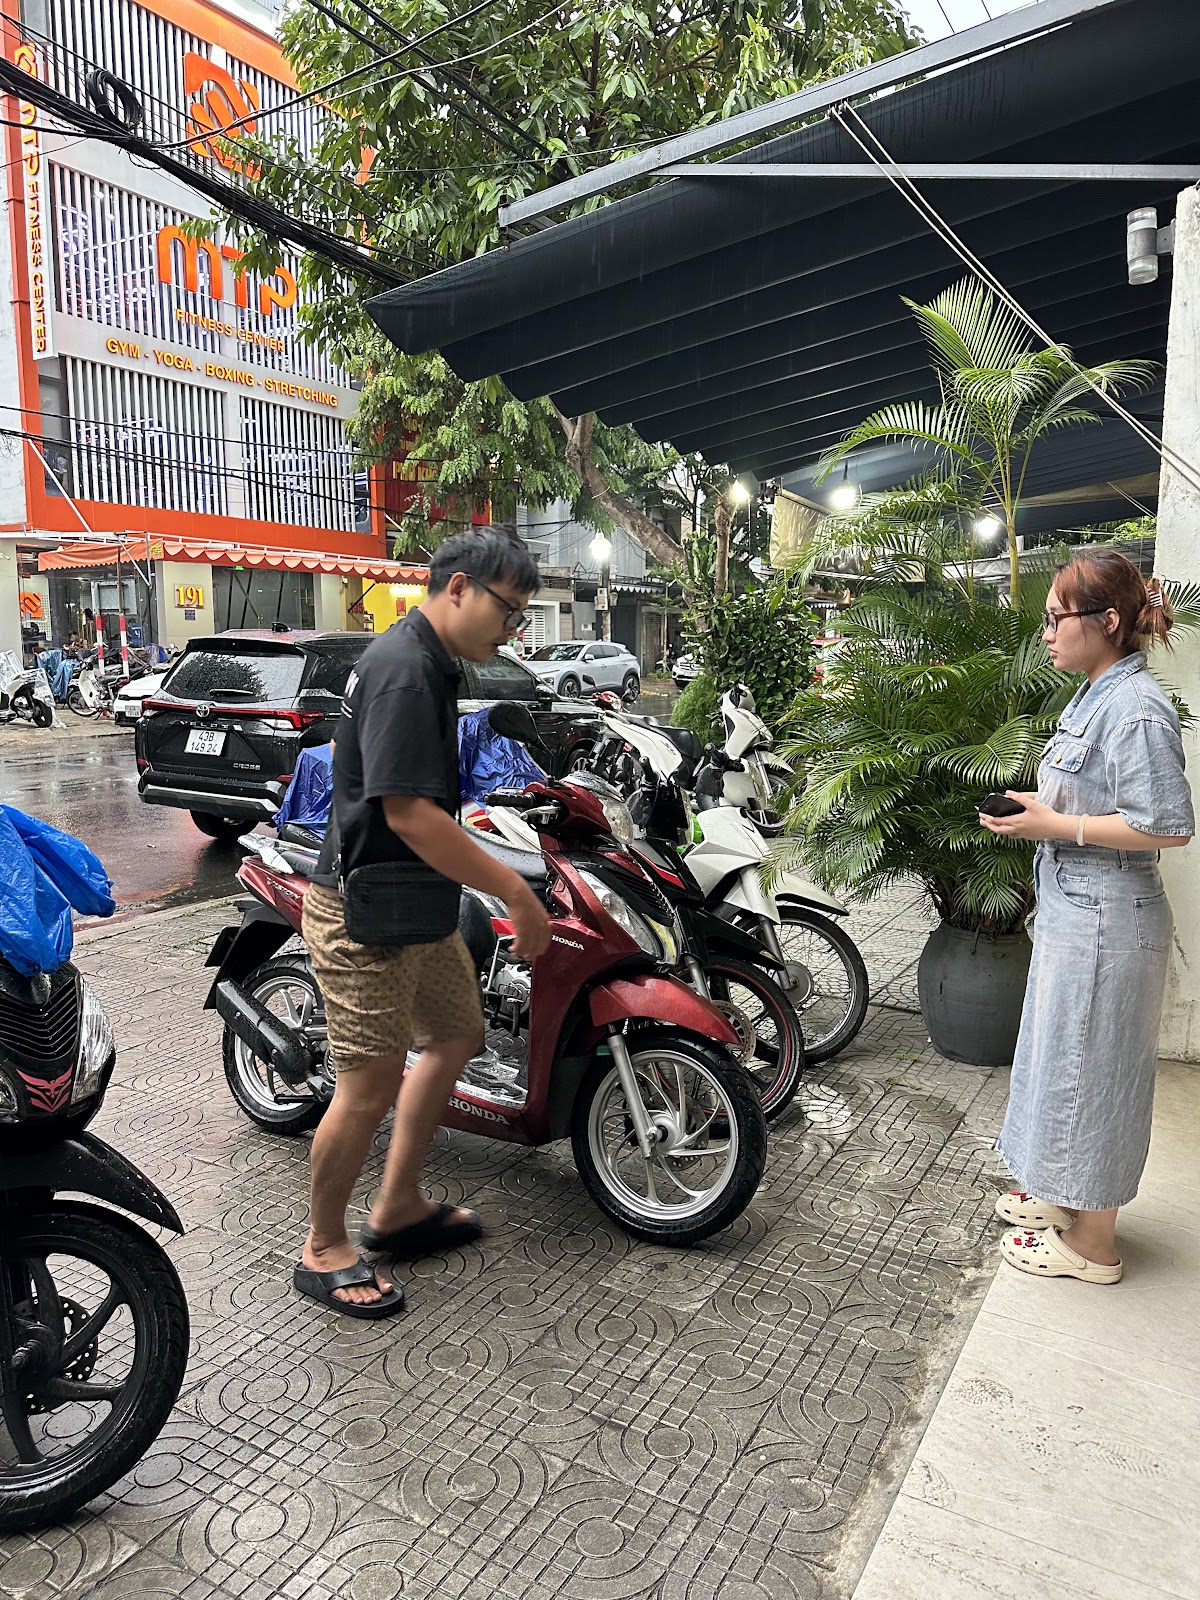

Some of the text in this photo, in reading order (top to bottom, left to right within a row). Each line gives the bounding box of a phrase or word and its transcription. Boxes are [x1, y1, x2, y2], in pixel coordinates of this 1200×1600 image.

[28, 181, 47, 353] FITNESS CENTER
[176, 308, 285, 353] FITNESS CENTER
[106, 337, 141, 359] GYM
[153, 348, 194, 372] YOGA
[205, 361, 255, 387] BOXING
[264, 377, 338, 407] STRETCHING
[175, 585, 205, 607] 191
[190, 741, 218, 753] 149.24
[198, 730, 215, 742] 43B
[551, 934, 585, 951] HONDA
[447, 1095, 511, 1126] HONDA
